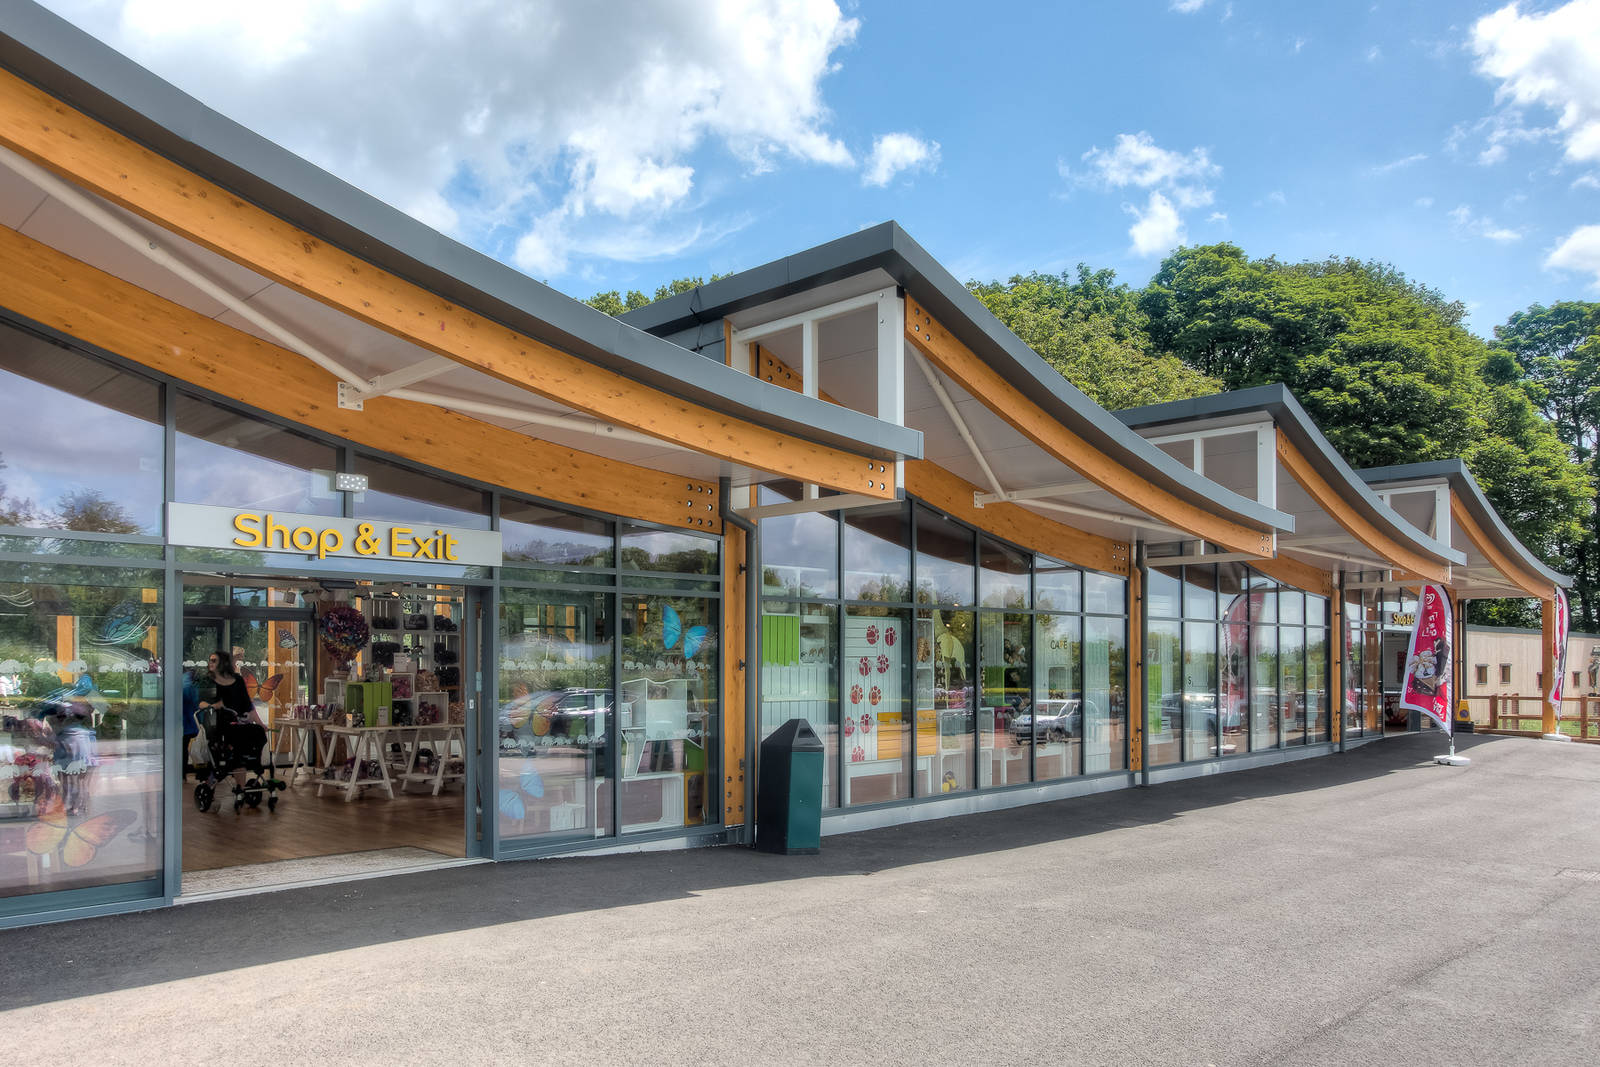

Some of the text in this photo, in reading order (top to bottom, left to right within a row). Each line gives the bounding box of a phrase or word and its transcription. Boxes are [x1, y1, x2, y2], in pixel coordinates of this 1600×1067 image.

[233, 513, 460, 561] Shop & Exit
